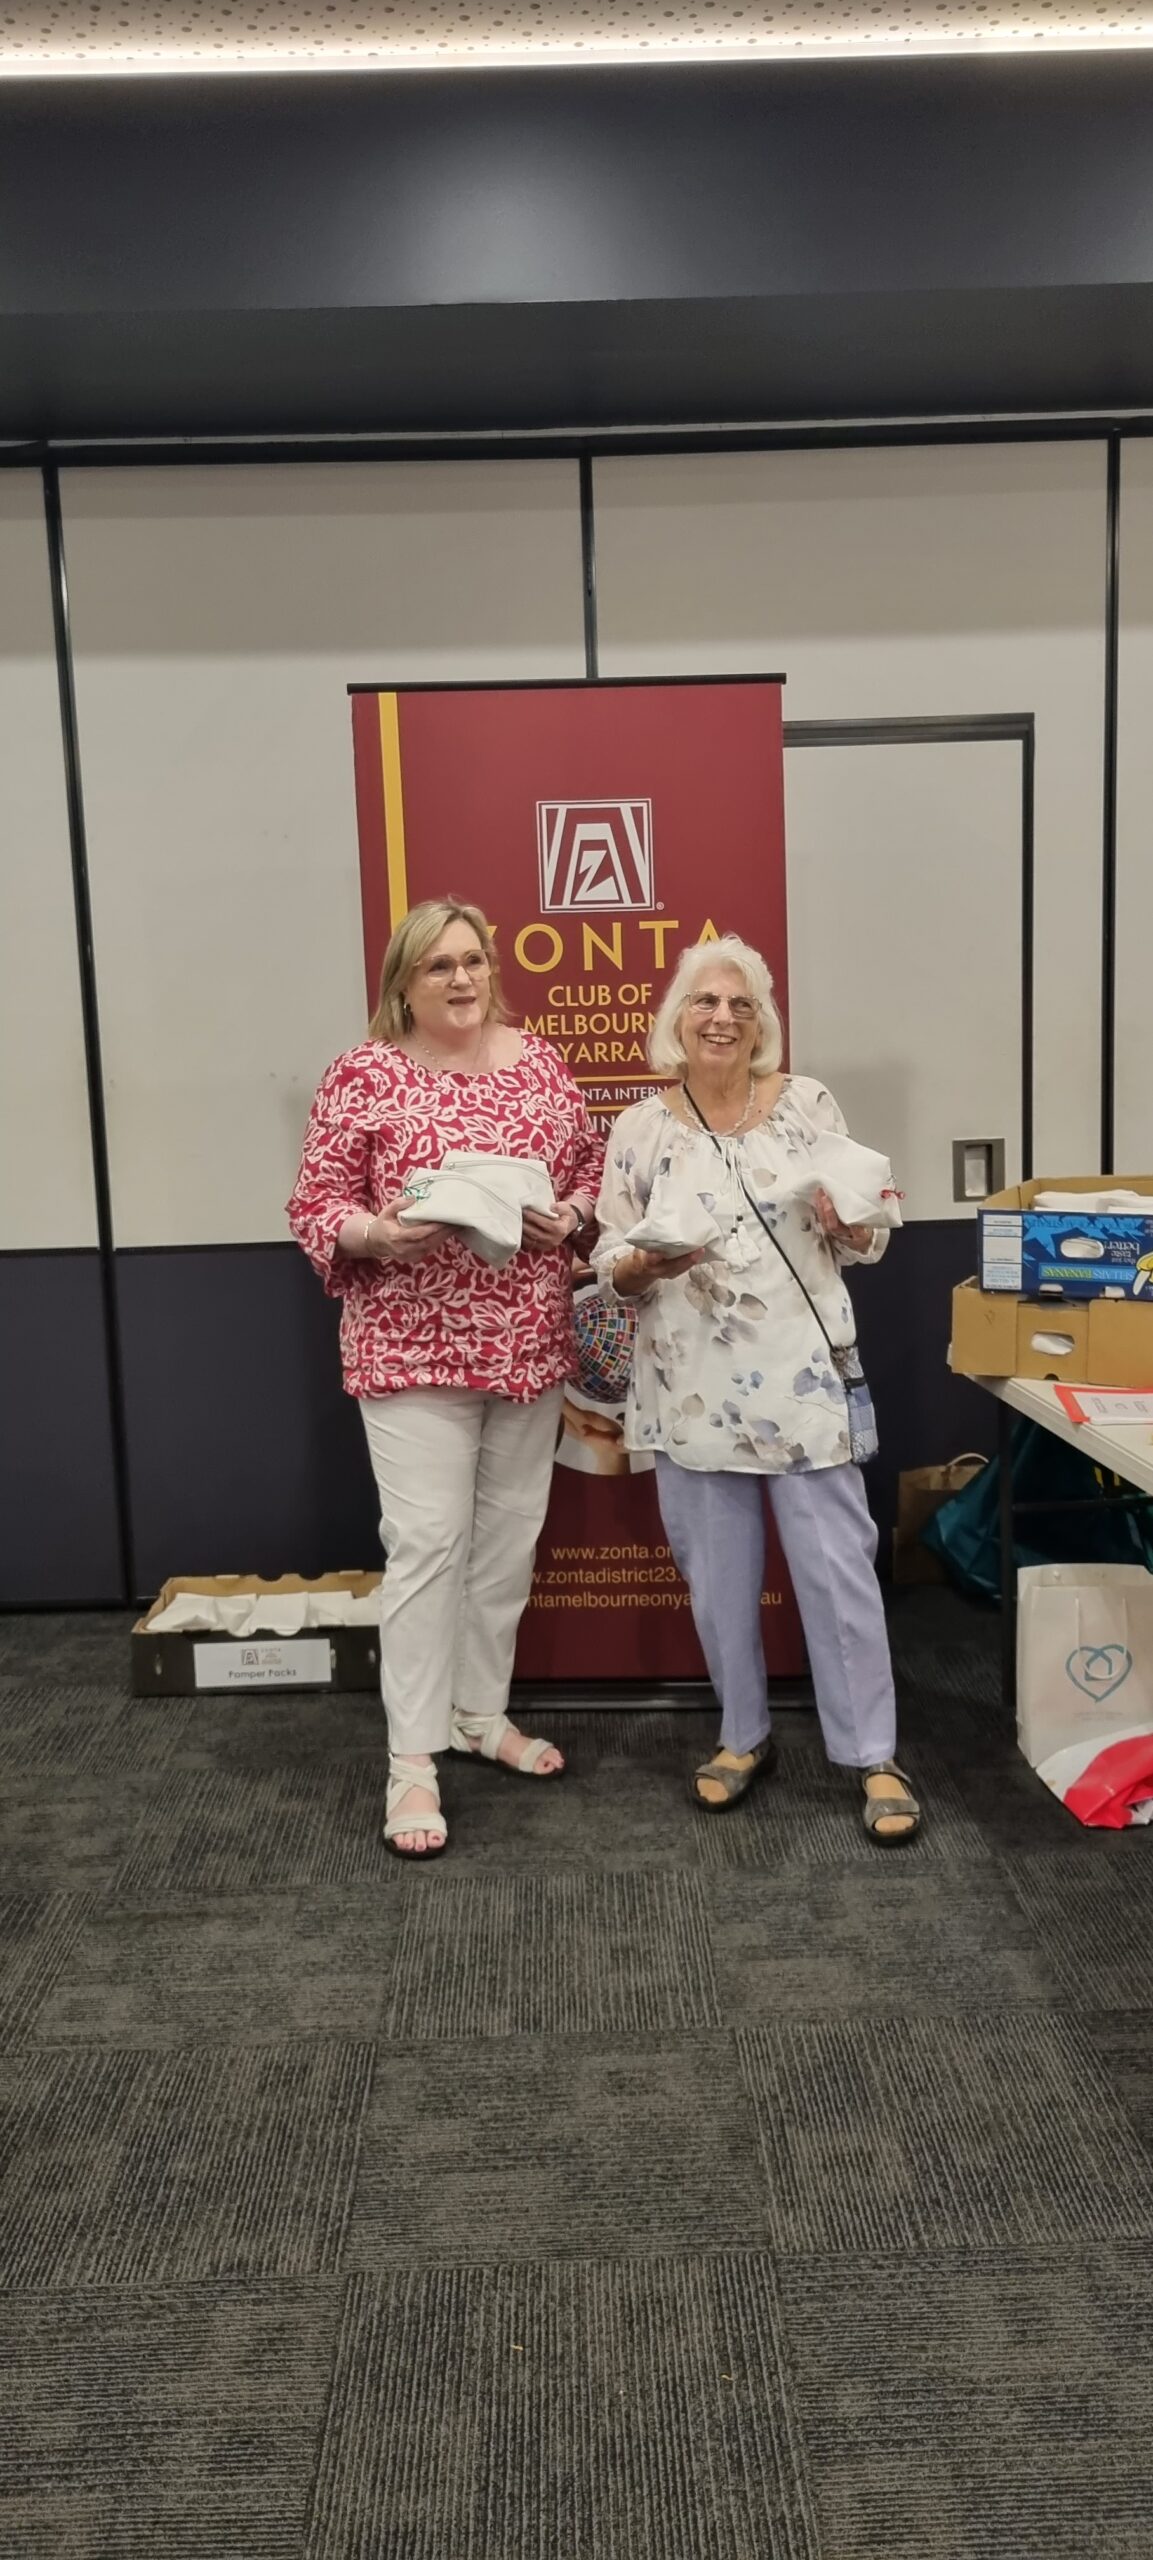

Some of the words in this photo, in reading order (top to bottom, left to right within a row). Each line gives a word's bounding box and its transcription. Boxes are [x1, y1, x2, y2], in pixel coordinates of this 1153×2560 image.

[486, 919, 720, 973] ONT
[548, 985, 611, 1007] CLUB
[618, 983, 653, 1005] OF
[524, 1011, 657, 1035] MELBOURN
[557, 1041, 646, 1063] YARRA
[551, 1544, 671, 1560] www.zonta.or
[228, 1670, 266, 1679] Pamper
[268, 1668, 297, 1678] Packs
